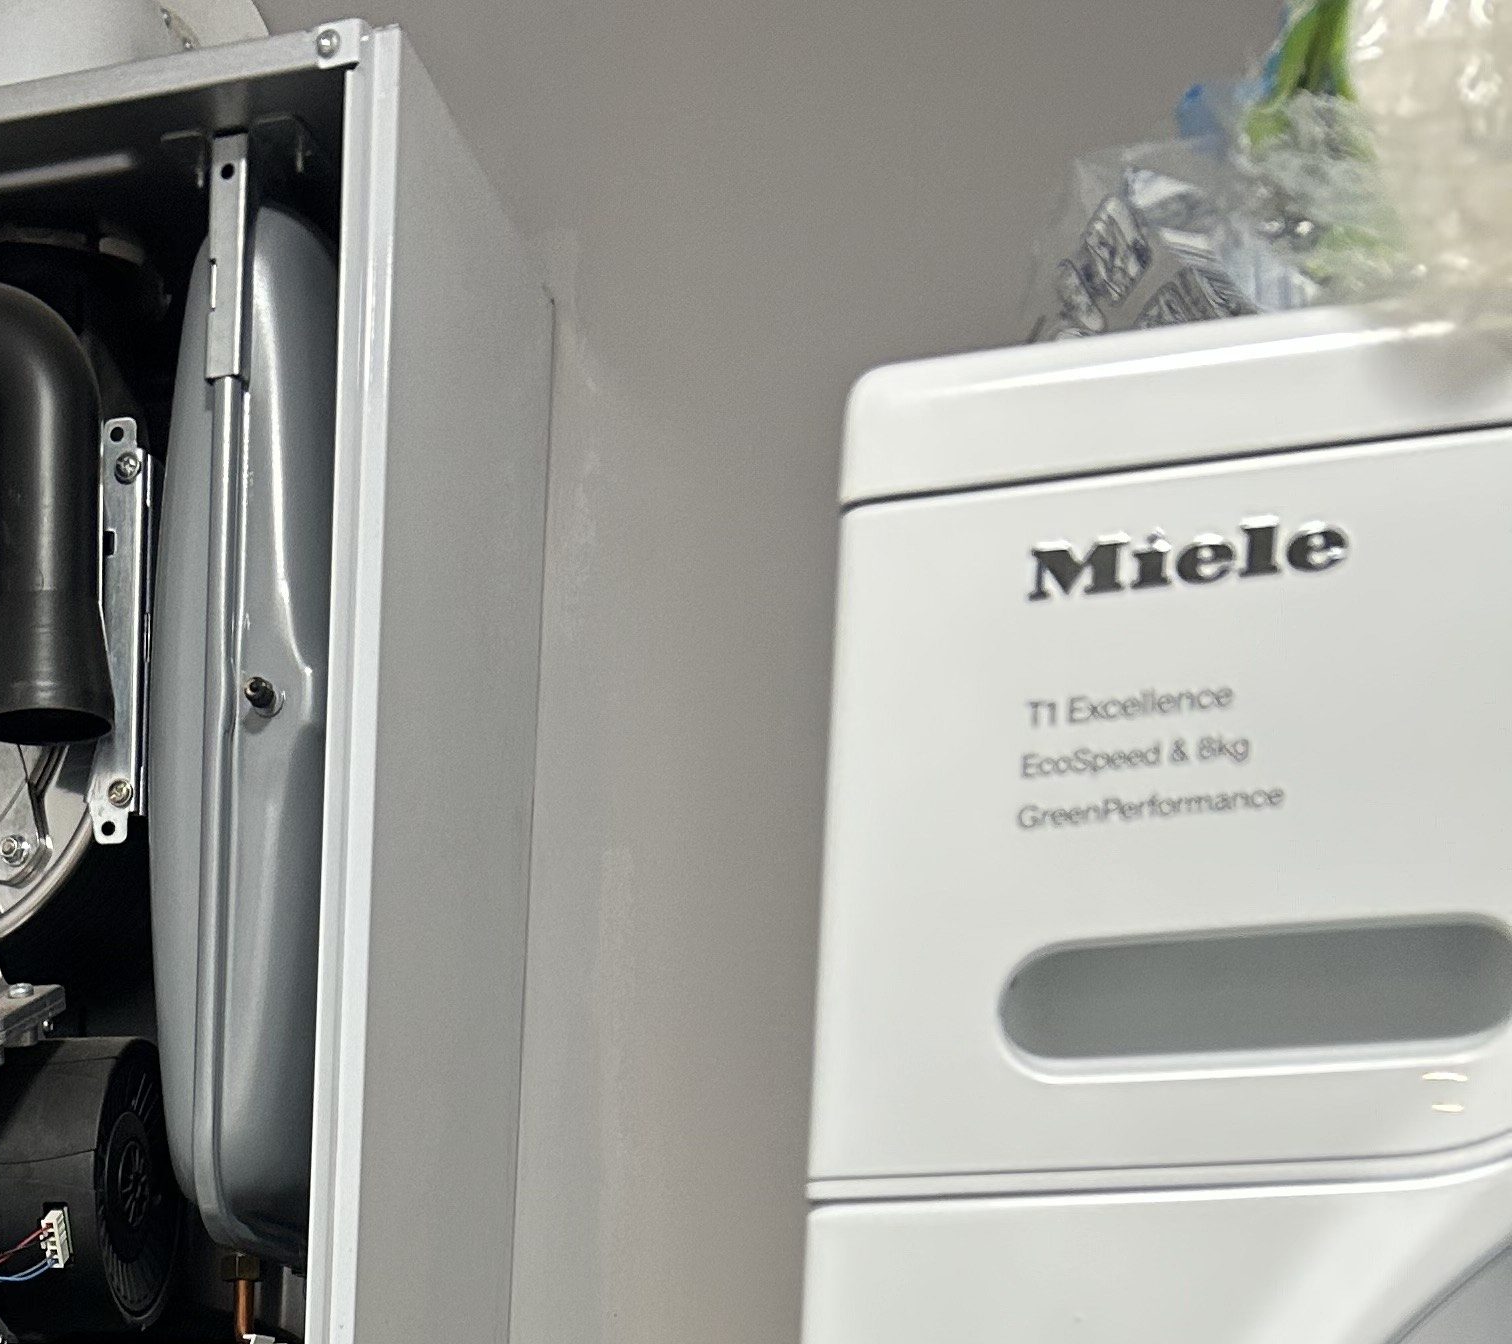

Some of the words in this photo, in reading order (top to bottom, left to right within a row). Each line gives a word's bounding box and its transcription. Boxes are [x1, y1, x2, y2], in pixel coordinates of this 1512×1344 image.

[1026, 513, 1349, 602] Miele
[1067, 686, 1235, 725] Excellence
[1020, 741, 1161, 779] EcoSpeed
[1170, 738, 1188, 765] &
[1197, 735, 1251, 765] 8kg
[1016, 786, 1285, 831] GreenPerformance
